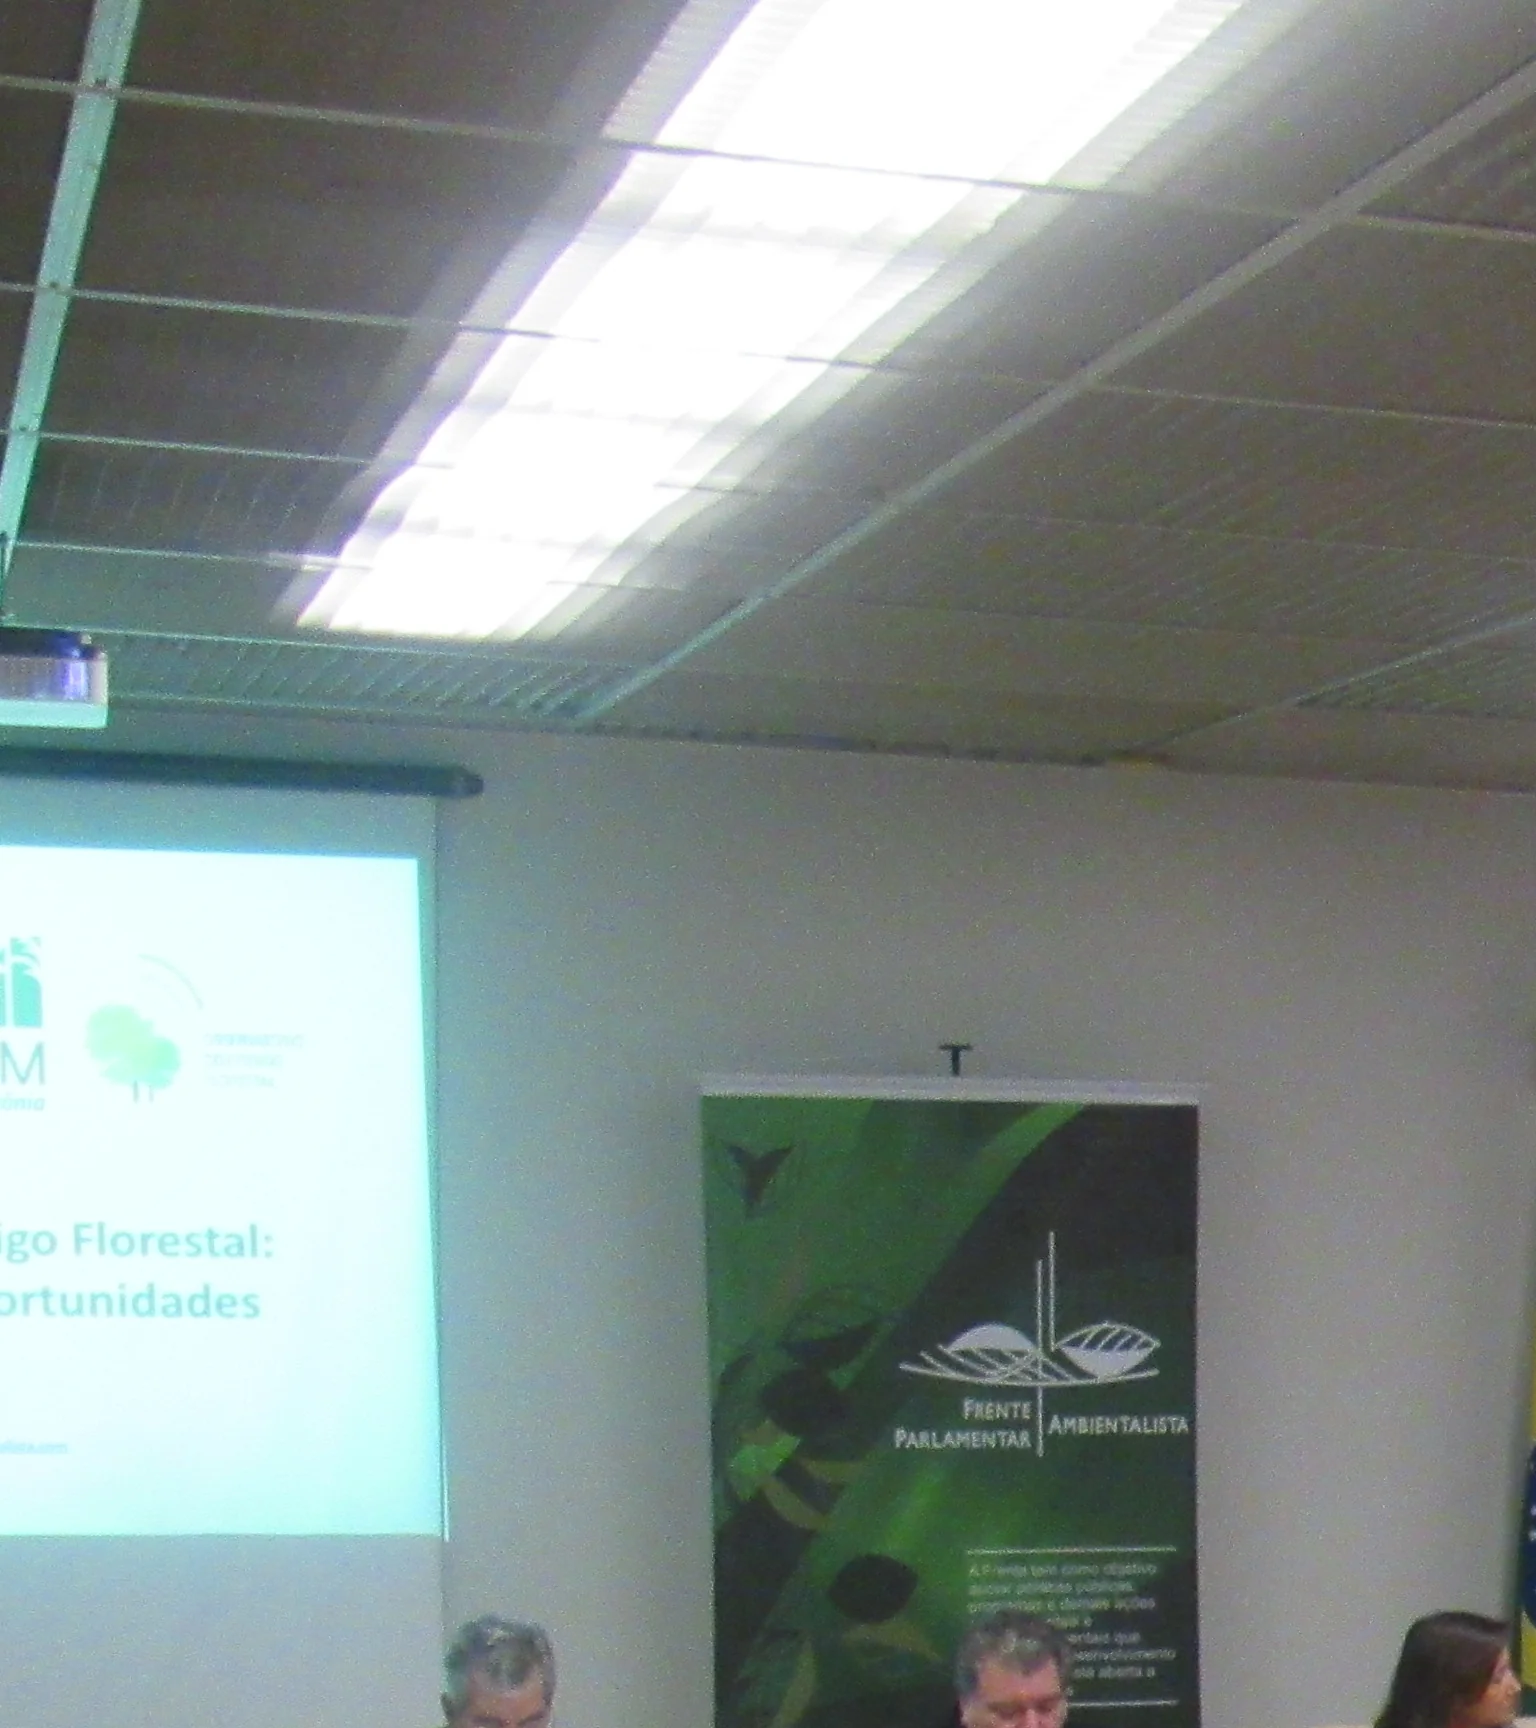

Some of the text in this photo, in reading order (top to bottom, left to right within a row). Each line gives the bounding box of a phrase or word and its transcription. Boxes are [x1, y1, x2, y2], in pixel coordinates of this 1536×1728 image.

[73, 1220, 274, 1258] Florestal:
[962, 1398, 1032, 1421] FRENTE
[1049, 1413, 1190, 1435] AMBIENTALISTA
[894, 1426, 1032, 1449] PARLAMENTAR
